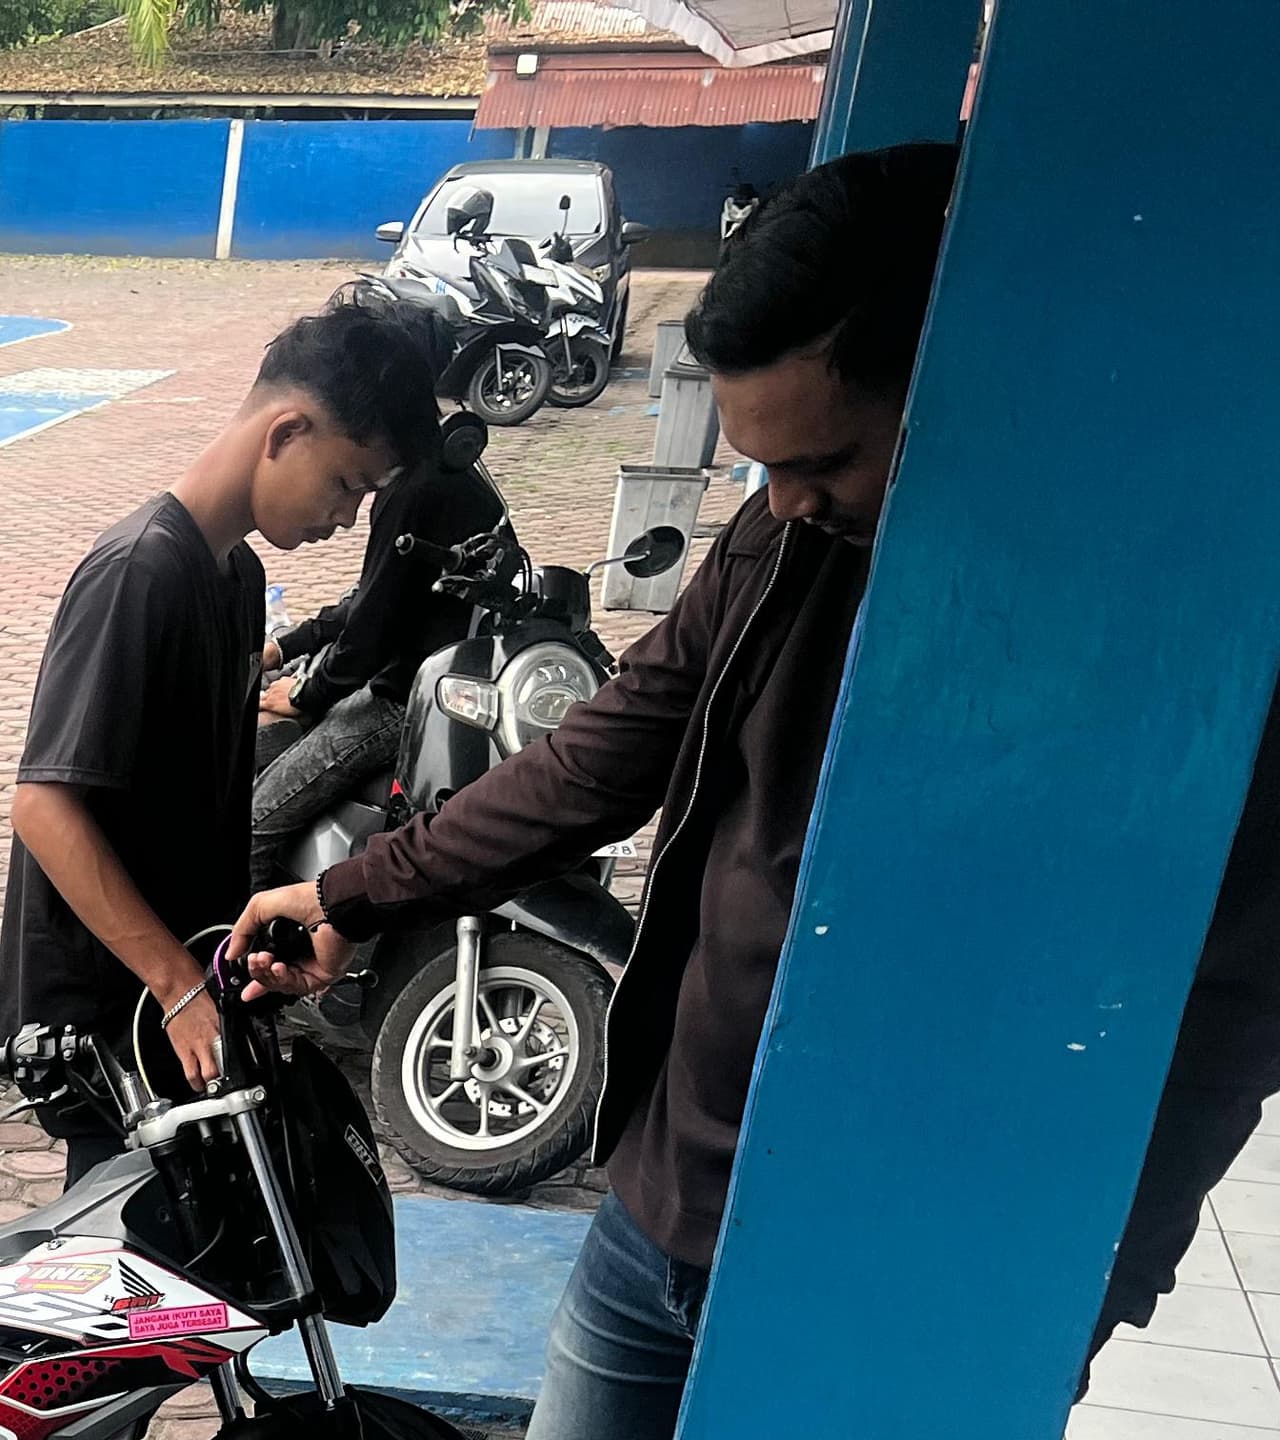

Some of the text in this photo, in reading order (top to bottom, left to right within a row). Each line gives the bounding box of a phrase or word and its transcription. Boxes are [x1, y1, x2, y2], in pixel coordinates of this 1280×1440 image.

[133, 1314, 170, 1325] JANGAN
[199, 1307, 223, 1317] SAYA
[134, 1323, 156, 1334] SAYA
[156, 1321, 180, 1331] JUGA
